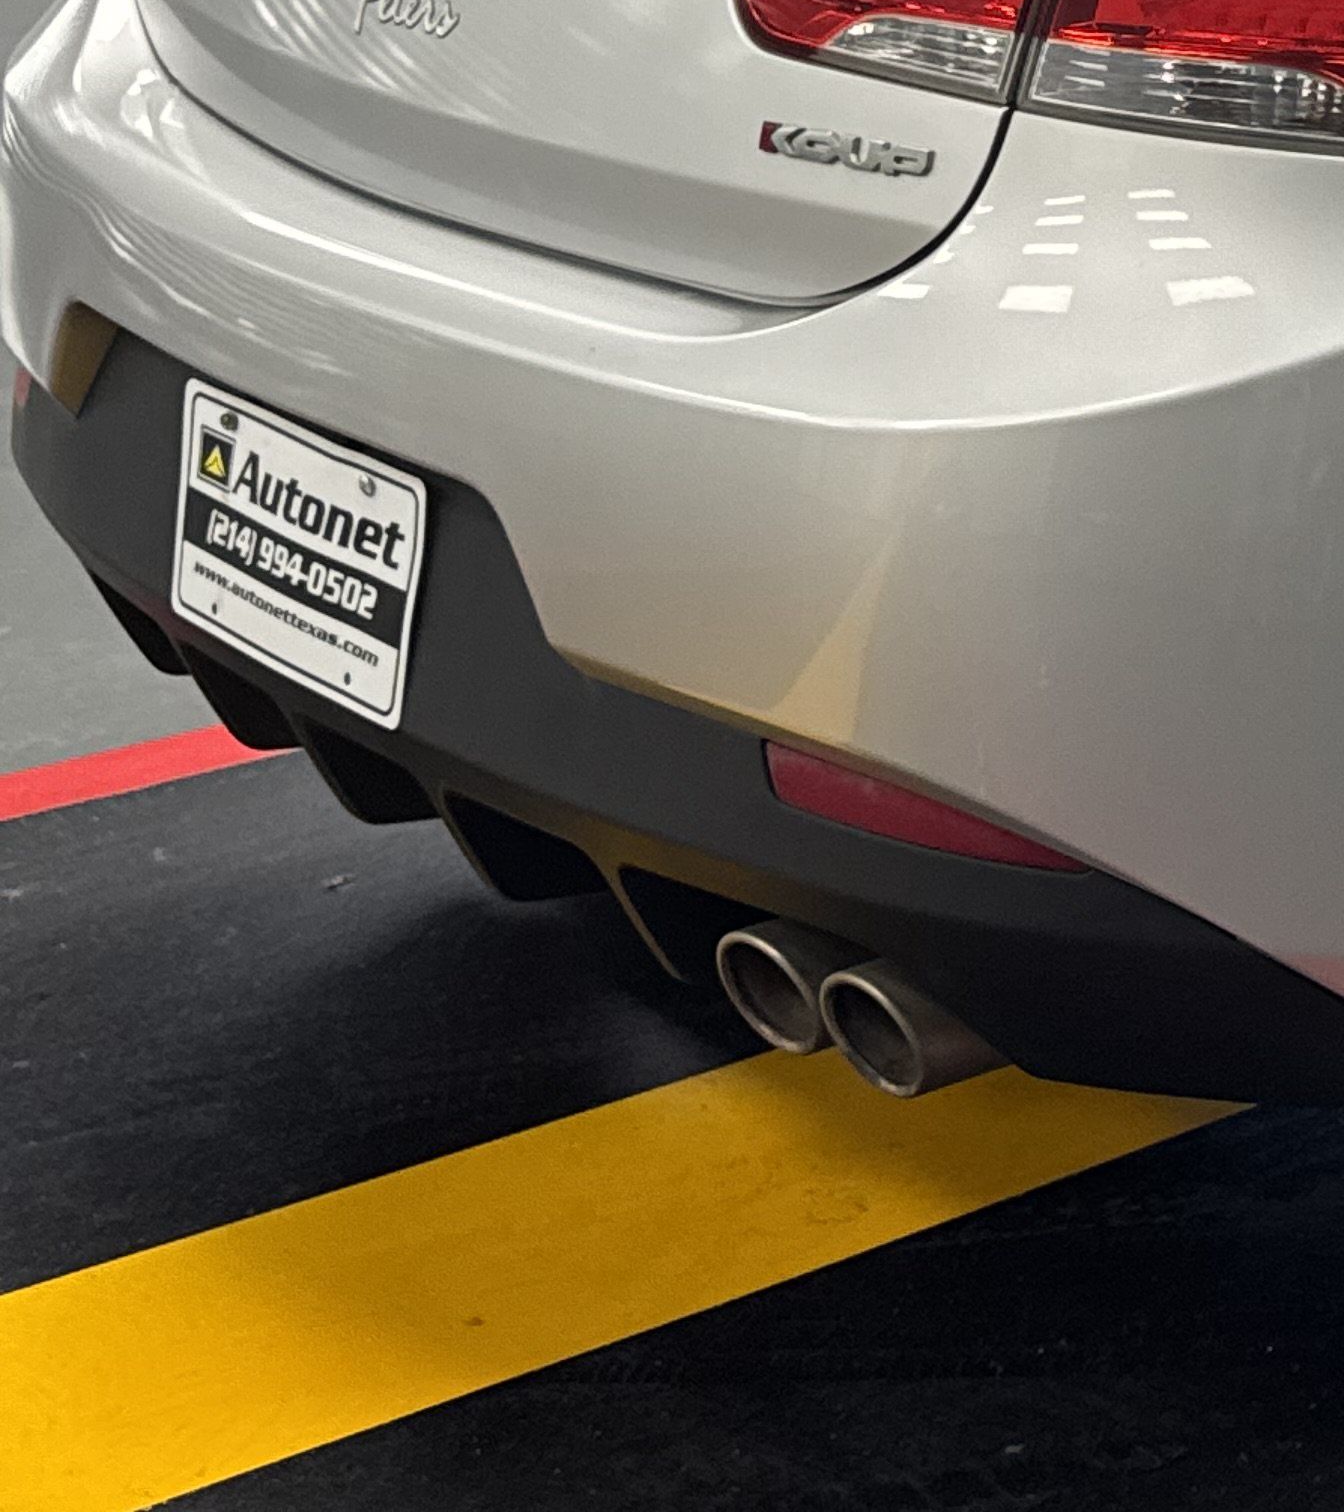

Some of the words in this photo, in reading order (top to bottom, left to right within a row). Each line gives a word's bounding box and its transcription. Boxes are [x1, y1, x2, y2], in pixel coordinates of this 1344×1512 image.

[206, 508, 258, 567] (214)
[258, 539, 378, 621] 994-0502
[231, 450, 406, 570] Autonet
[193, 560, 379, 668] www.autonettexas.com
